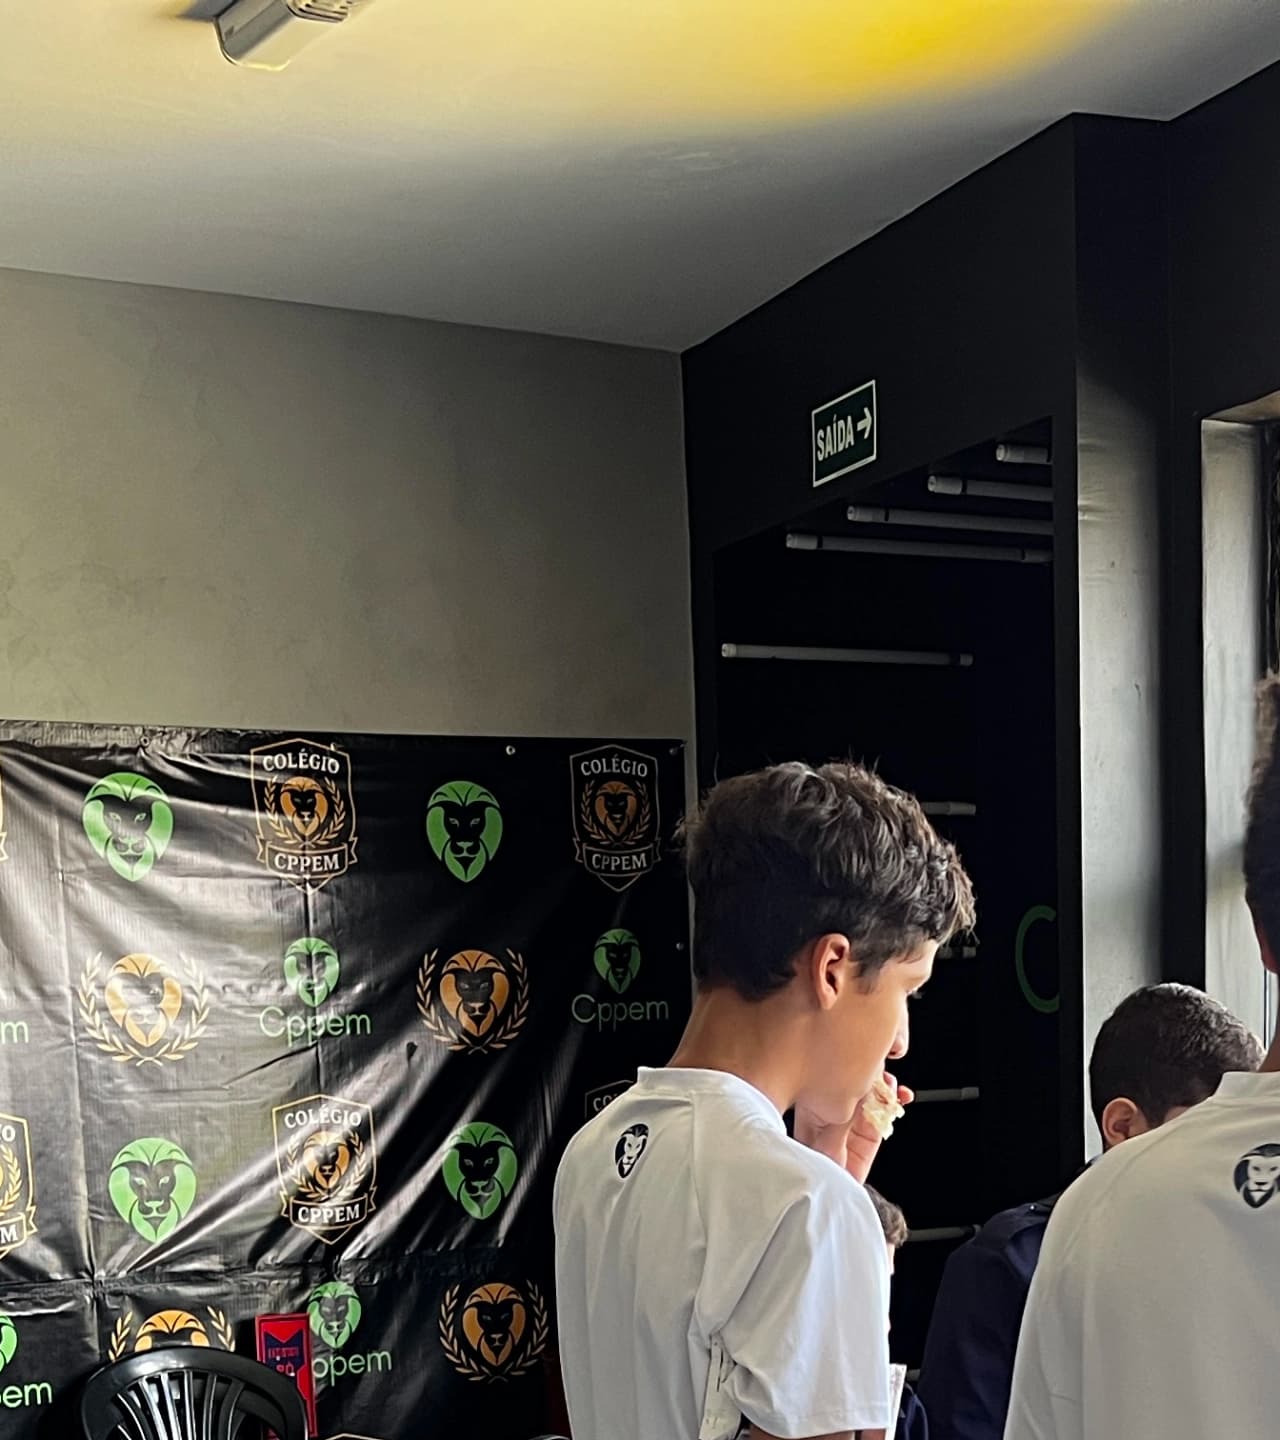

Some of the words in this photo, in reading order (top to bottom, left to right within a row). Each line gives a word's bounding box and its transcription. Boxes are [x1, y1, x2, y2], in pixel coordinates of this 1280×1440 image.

[817, 413, 855, 462] SAÍDA
[262, 748, 340, 774] COLÉGIO
[580, 754, 648, 778] COLÉGIO
[273, 853, 340, 872] CPPEM
[591, 853, 647, 870] CPPEM
[571, 993, 669, 1030] Cppem
[259, 1005, 371, 1046] Cppem
[283, 1105, 362, 1129] COLÉGIO
[297, 1204, 361, 1223] CPPEM
